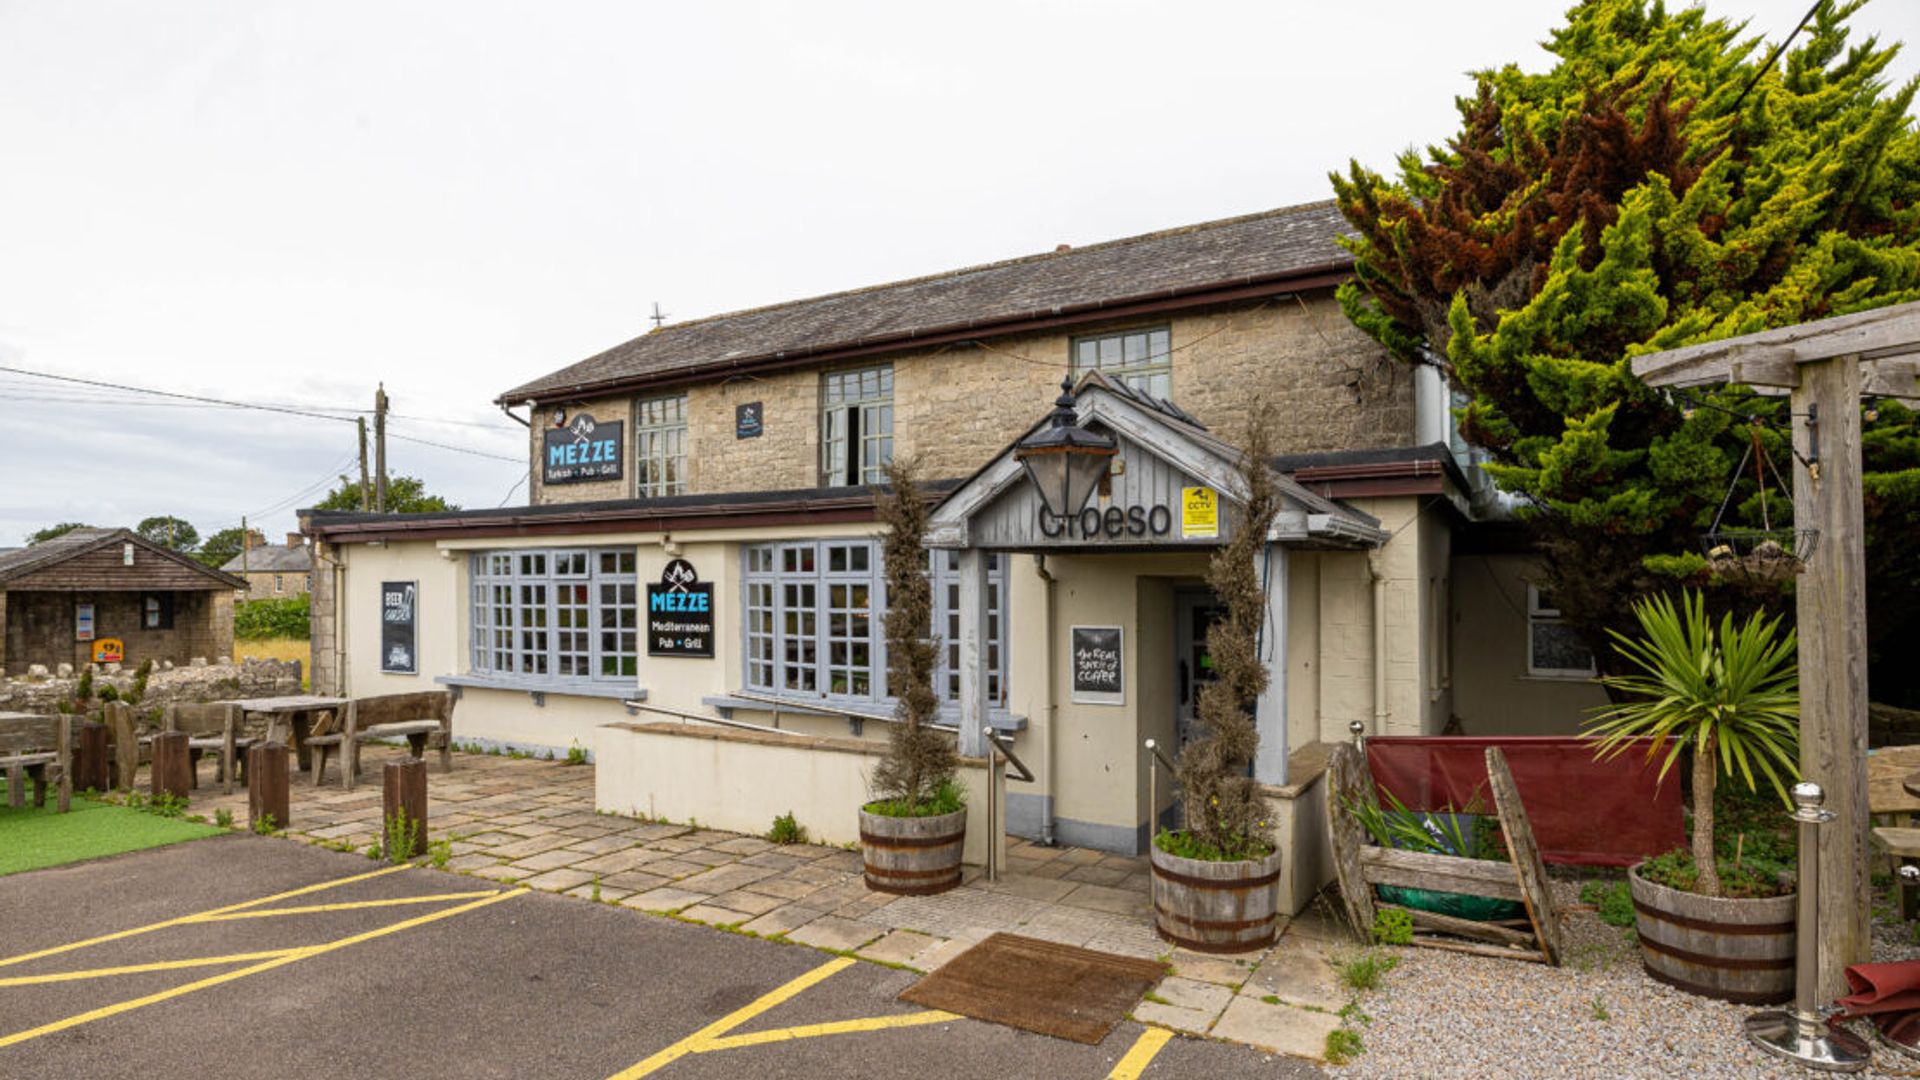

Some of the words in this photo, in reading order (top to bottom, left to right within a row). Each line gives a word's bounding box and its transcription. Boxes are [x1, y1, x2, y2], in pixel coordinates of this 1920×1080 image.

[549, 440, 616, 466] MEZZE
[580, 467, 595, 476] Pub
[650, 592, 709, 613] MEZZE
[652, 621, 710, 633] Mediterranean
[659, 637, 674, 648] Pub
[684, 637, 702, 649] Grill
